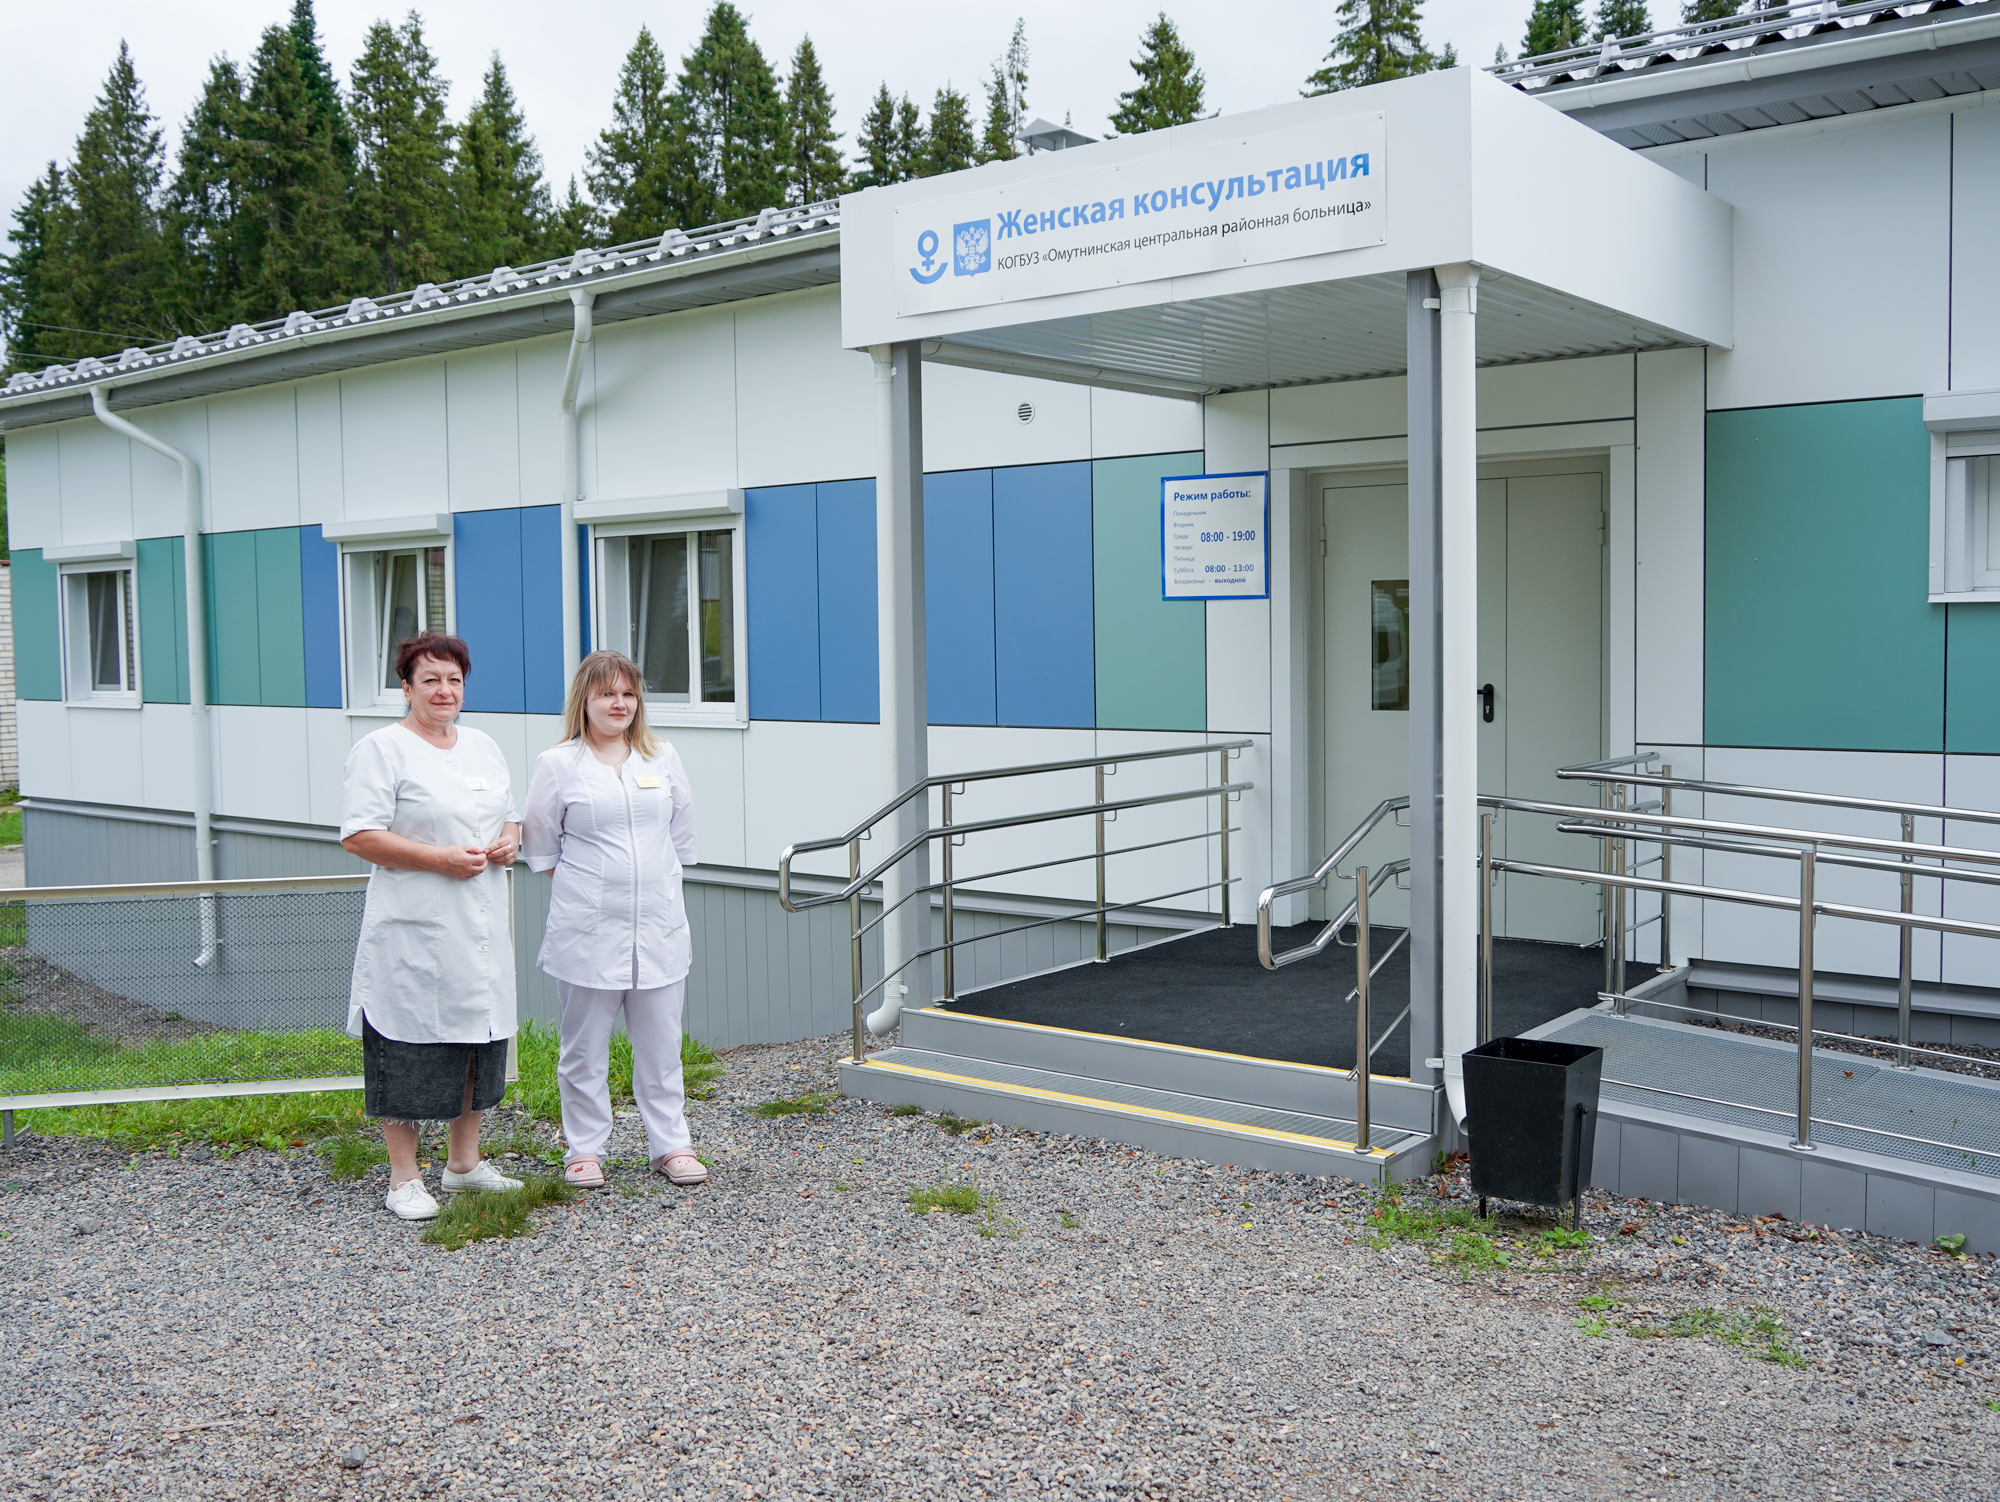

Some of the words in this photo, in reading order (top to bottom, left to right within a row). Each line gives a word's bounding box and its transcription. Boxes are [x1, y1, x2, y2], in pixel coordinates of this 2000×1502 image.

[997, 198, 1125, 240] Женская
[1134, 152, 1370, 216] консультация
[997, 251, 1040, 271] КОГБУЗ
[1042, 239, 1131, 263] «Омутнинская
[1134, 224, 1218, 250] центральная
[1222, 213, 1290, 237] районная
[1293, 200, 1372, 223] больница»
[1173, 492, 1208, 502] Режим
[1210, 488, 1252, 502] работы:
[1200, 532, 1224, 542] 08:00
[1232, 530, 1256, 541] 19:00
[1204, 564, 1226, 573] 08:00
[1233, 564, 1254, 572] 13:00
